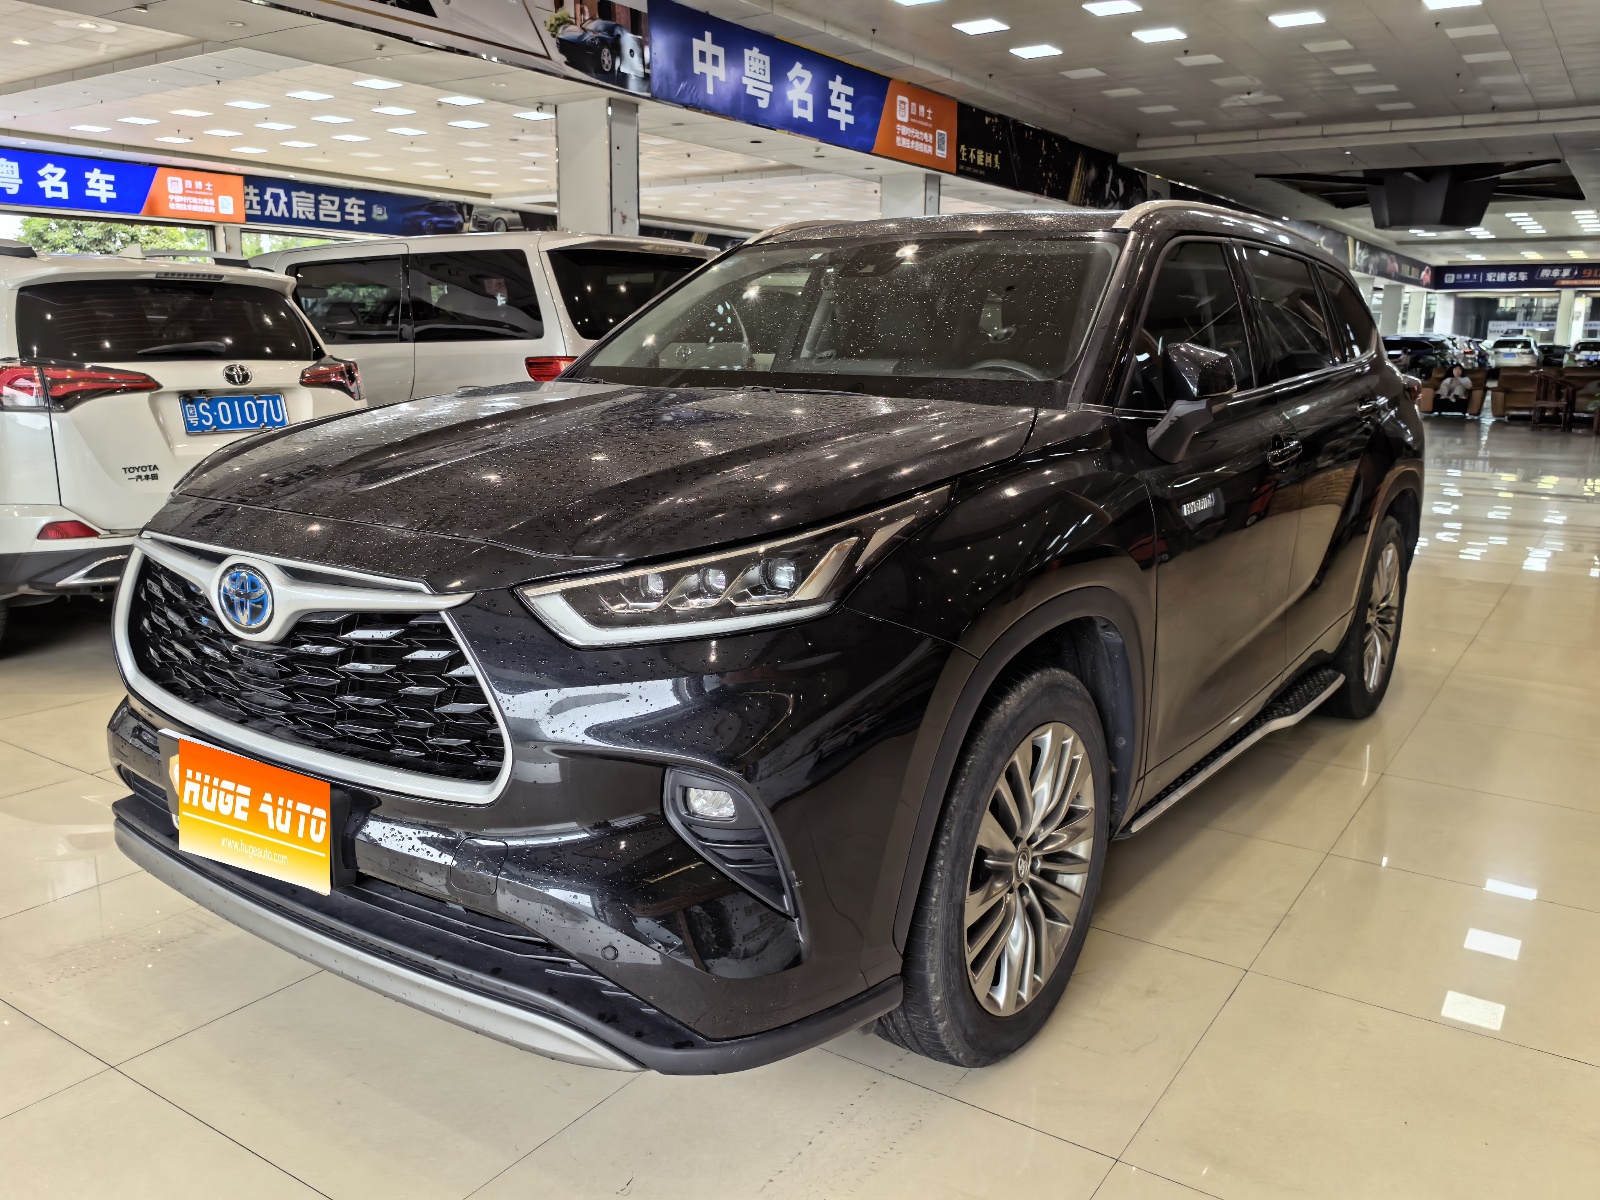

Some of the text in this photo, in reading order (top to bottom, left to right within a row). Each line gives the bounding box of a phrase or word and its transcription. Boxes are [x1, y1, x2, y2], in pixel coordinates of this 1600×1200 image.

[692, 31, 855, 131] 中粤名车
[122, 464, 159, 474] TOYOTA
[128, 473, 159, 482] 一汽丰田
